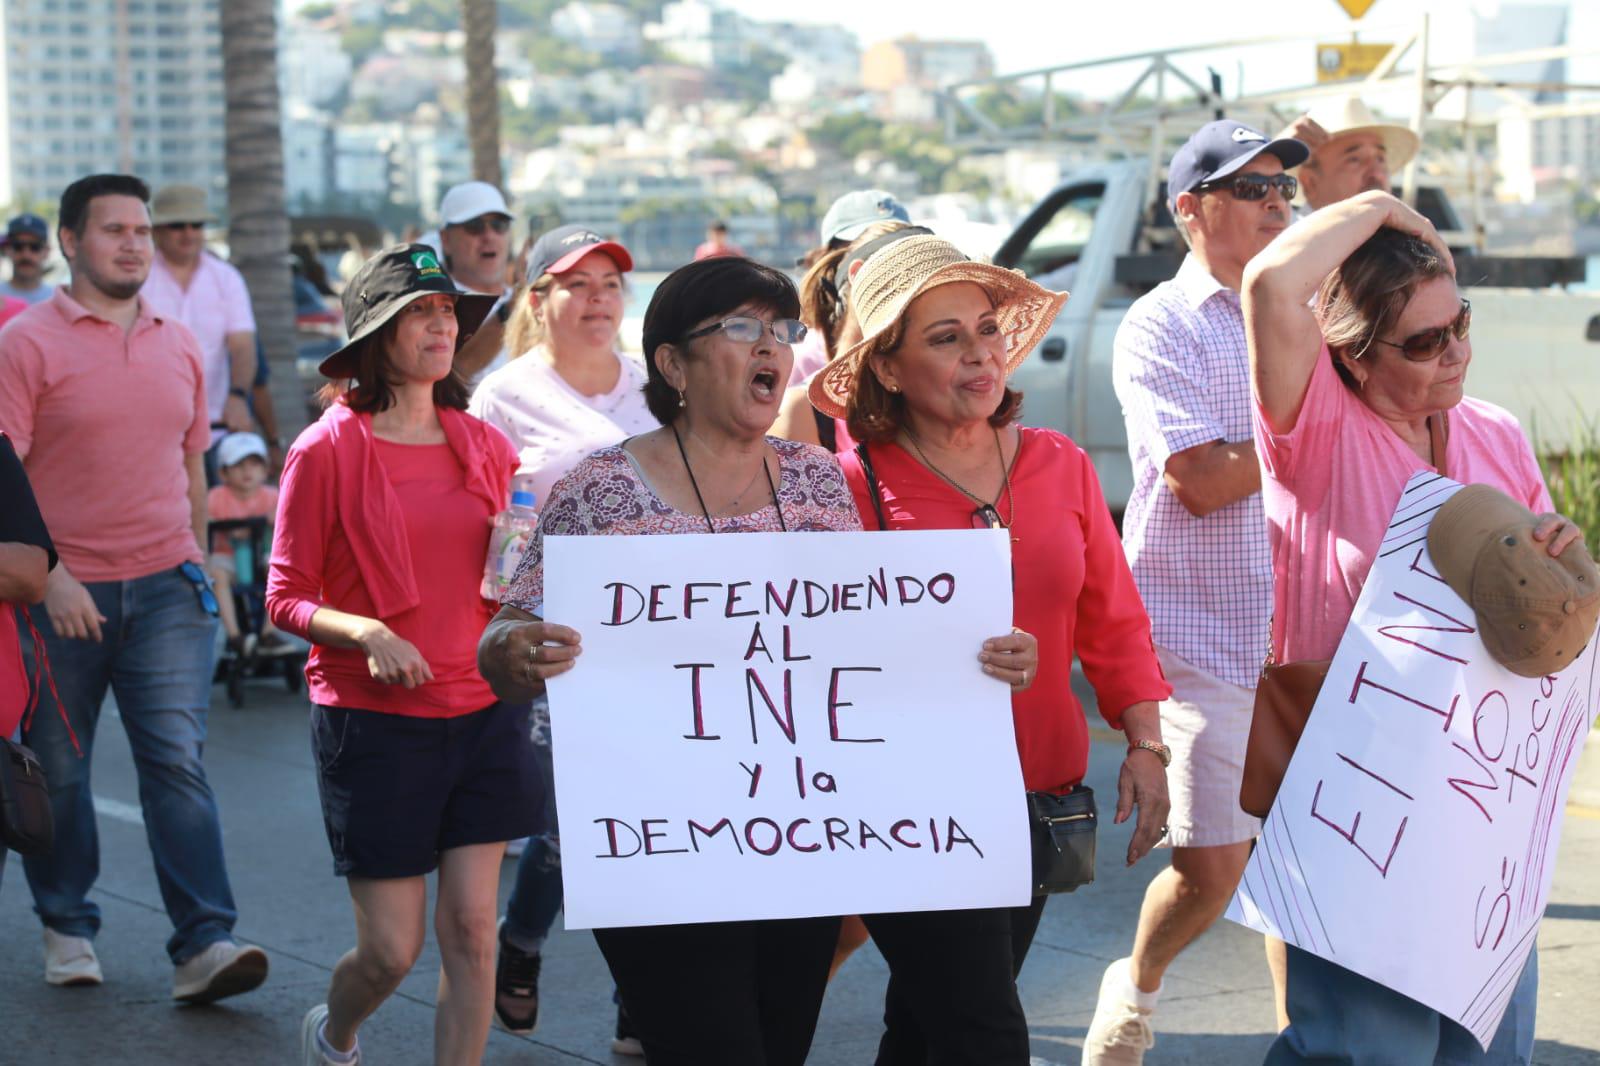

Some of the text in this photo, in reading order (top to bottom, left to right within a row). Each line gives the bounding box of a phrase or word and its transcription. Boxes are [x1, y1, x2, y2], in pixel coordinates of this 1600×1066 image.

[600, 567, 956, 626] DEFENDIENDO
[744, 622, 812, 663] AL
[673, 663, 886, 745] INE
[795, 756, 837, 800] la
[1447, 689, 1511, 824] NO
[593, 816, 985, 859] DEMOCRACIA
